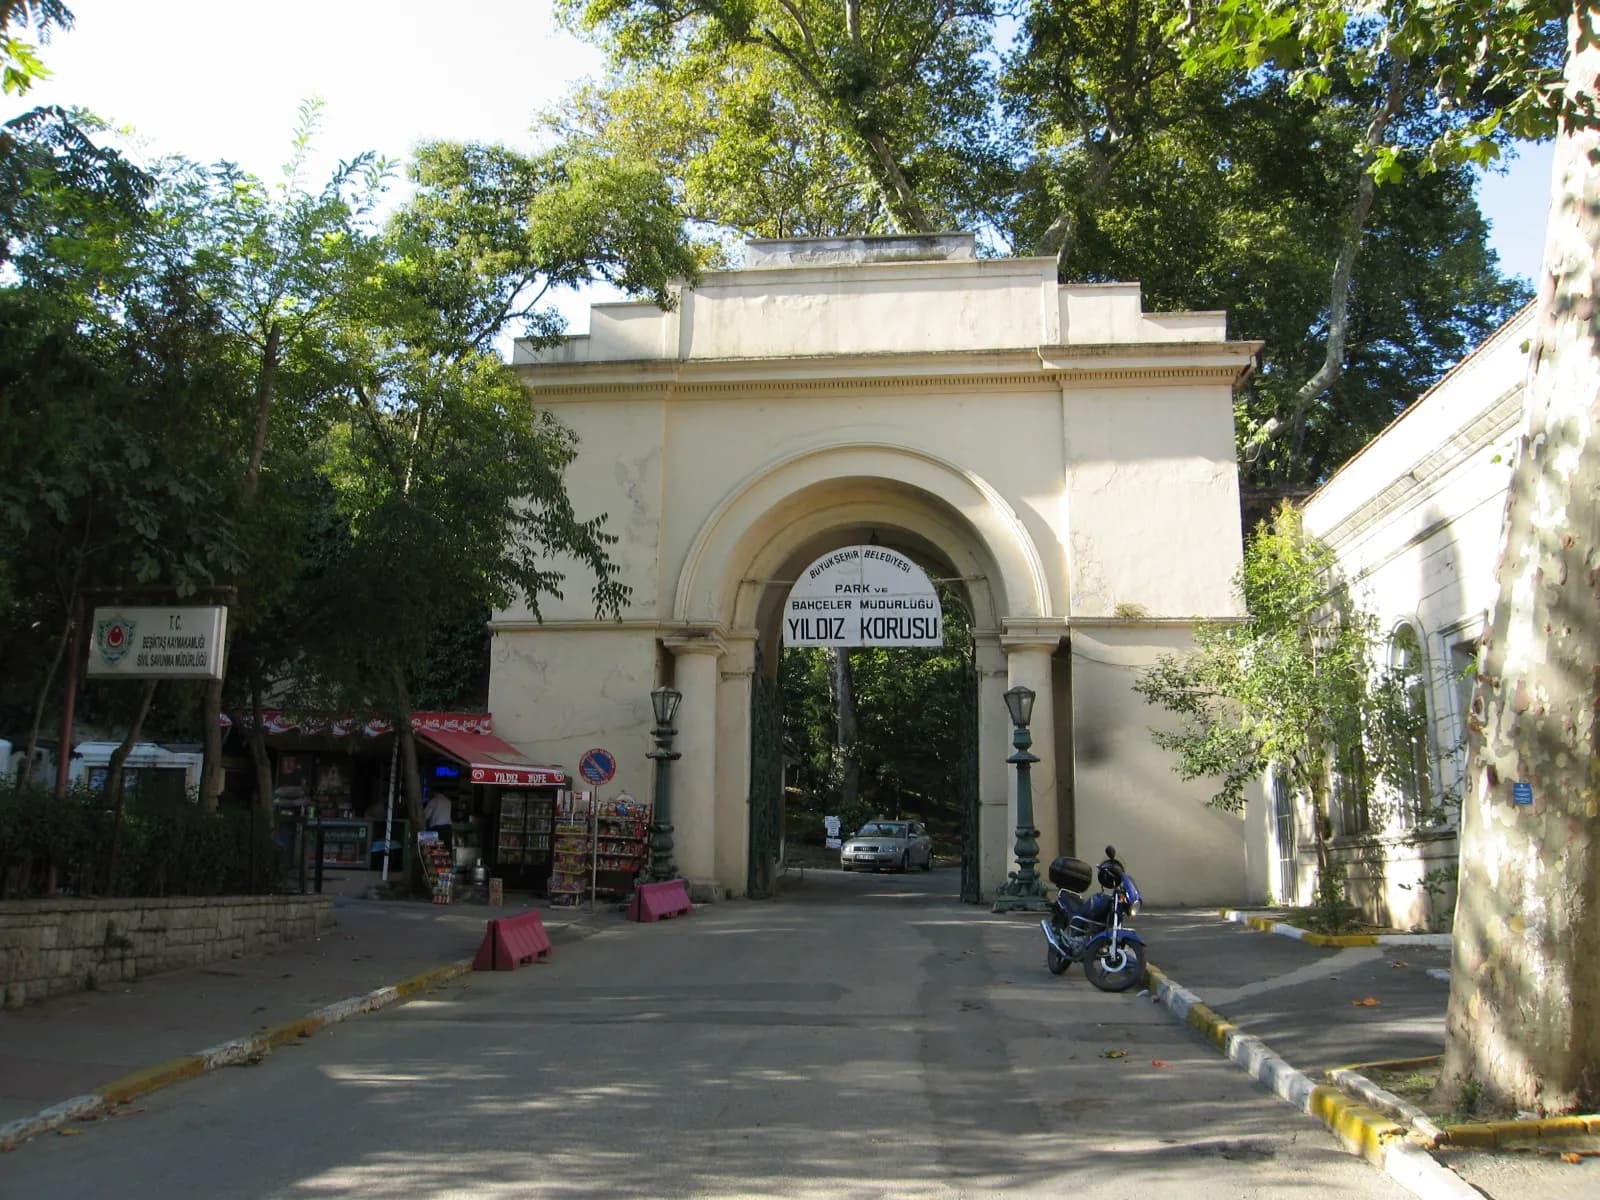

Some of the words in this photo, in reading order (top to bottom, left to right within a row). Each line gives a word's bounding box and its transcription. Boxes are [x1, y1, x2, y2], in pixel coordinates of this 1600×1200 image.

[835, 584, 870, 593] PARK
[788, 617, 845, 640] YILDIZ
[860, 617, 938, 640] KORUSU
